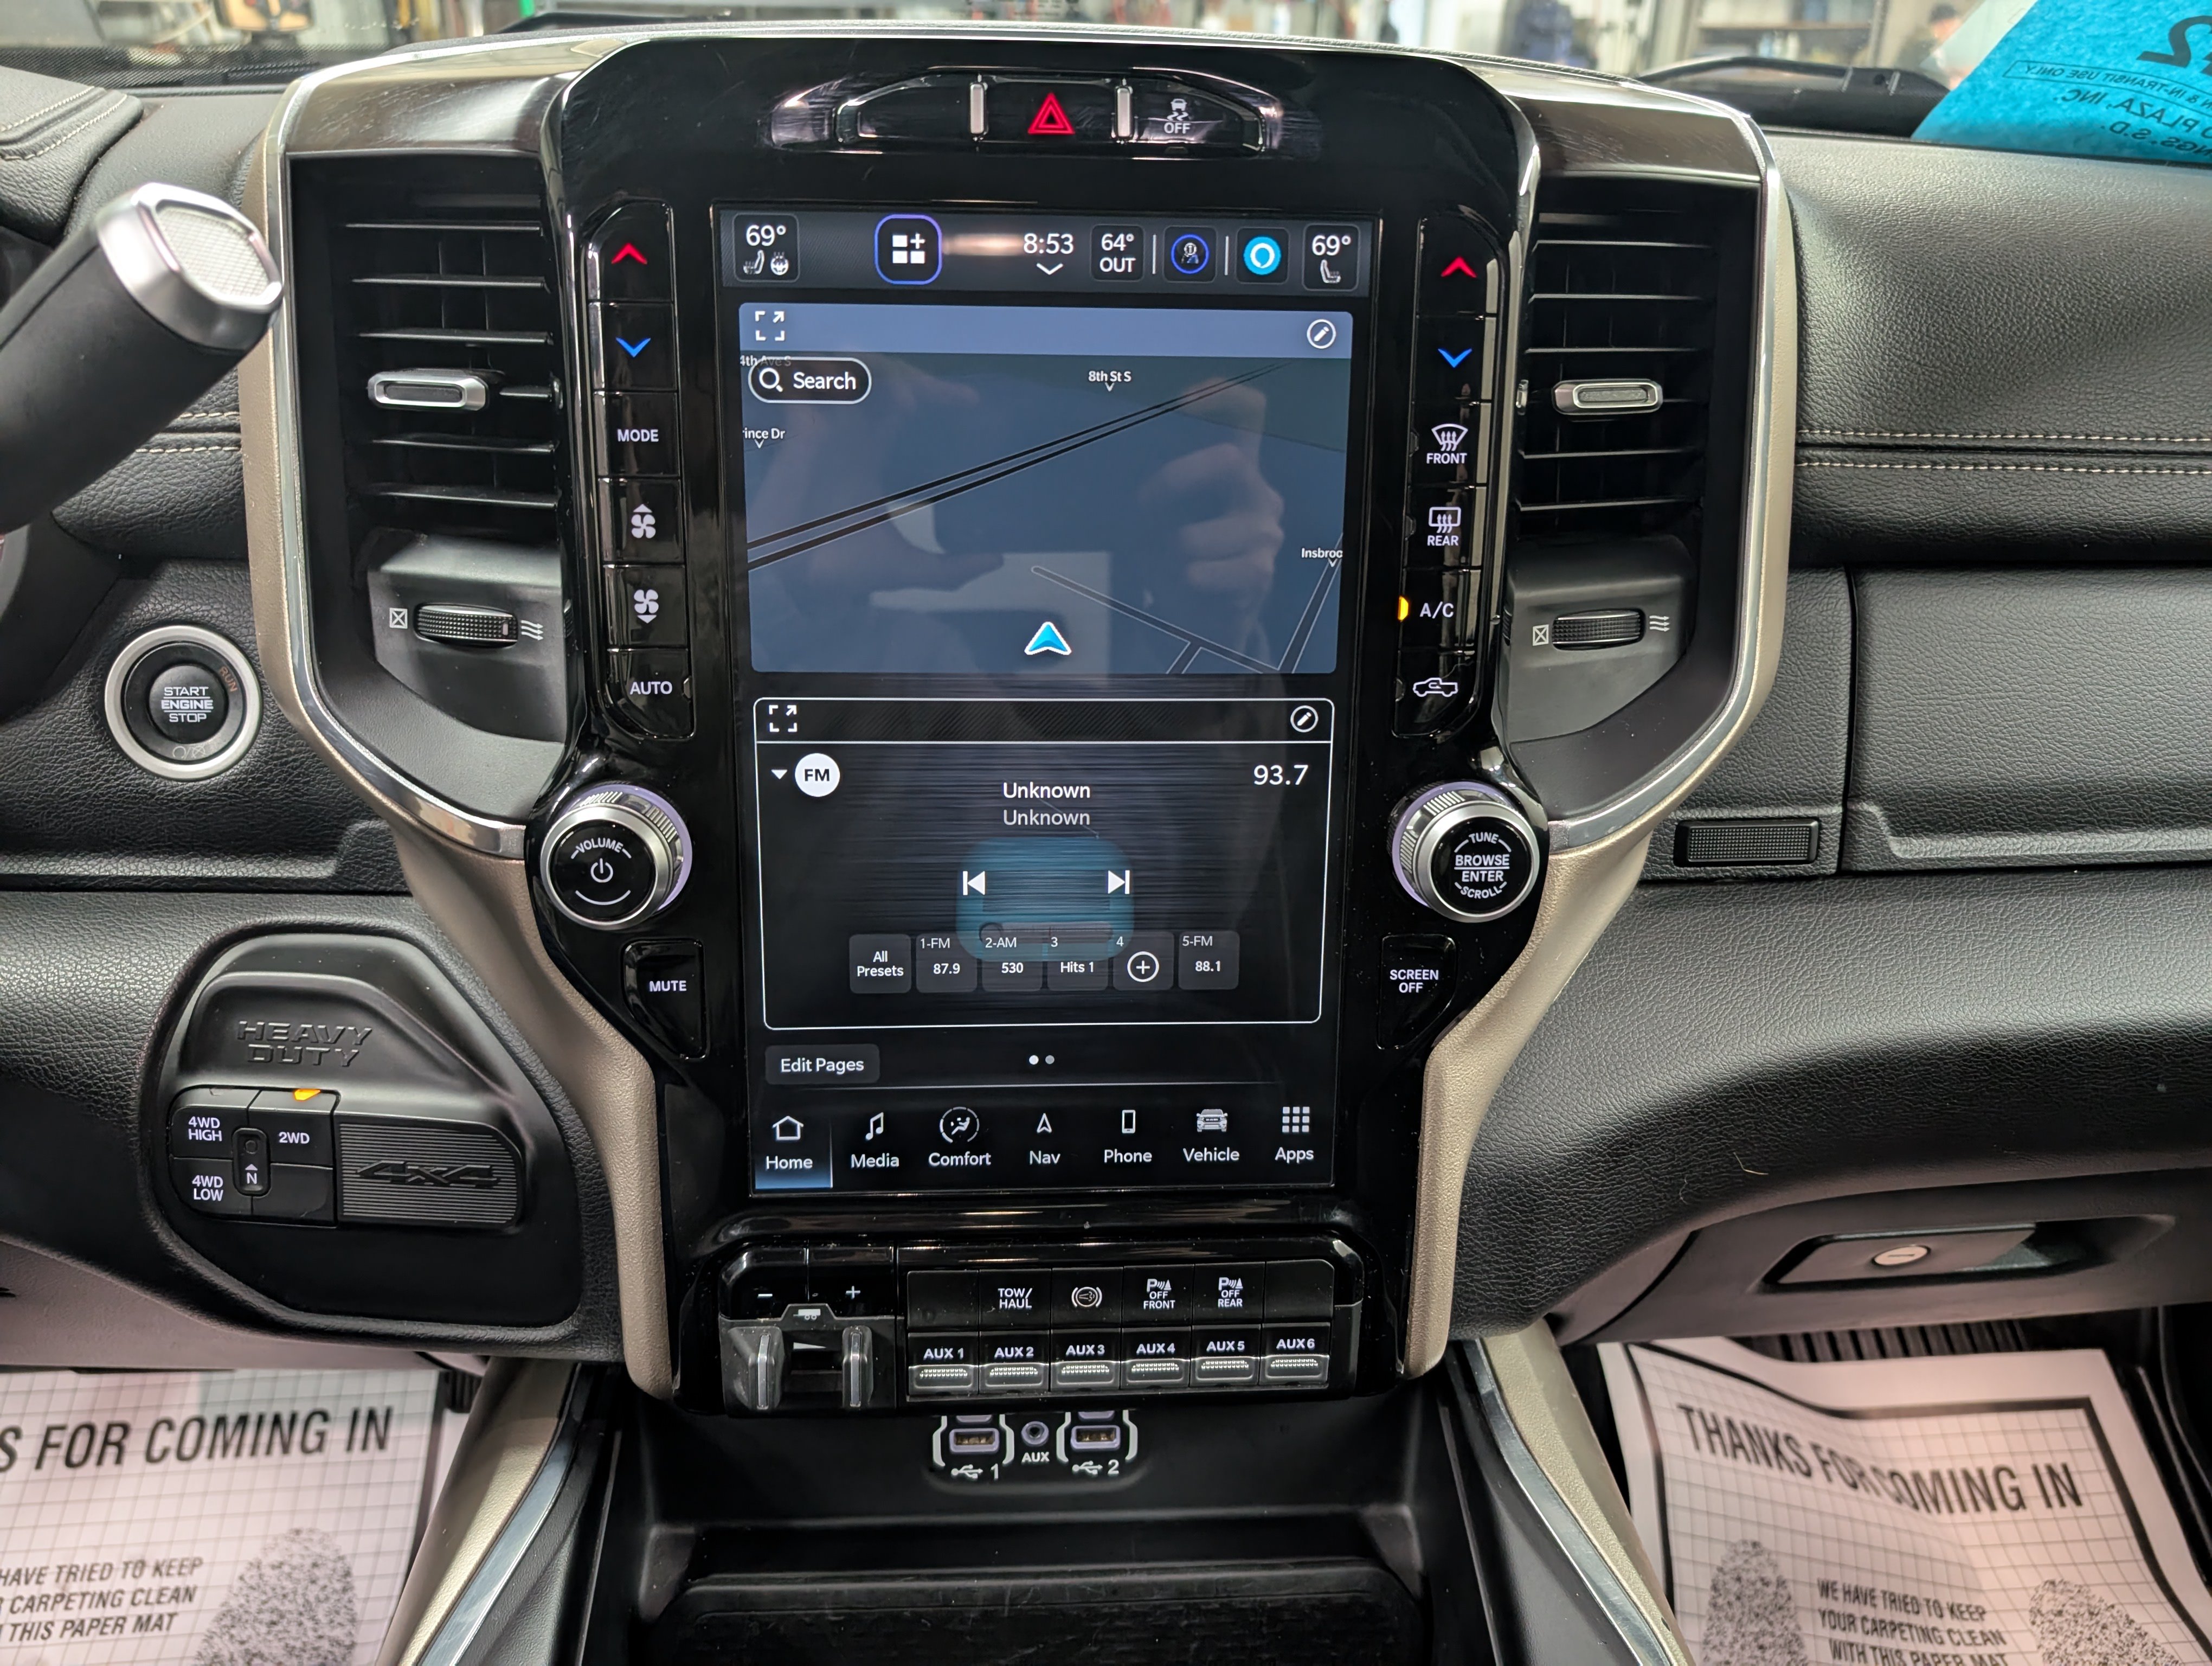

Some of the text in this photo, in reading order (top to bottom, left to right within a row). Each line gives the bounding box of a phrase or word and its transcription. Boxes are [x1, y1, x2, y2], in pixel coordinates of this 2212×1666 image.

[1163, 122, 1191, 133] OFF
[1023, 233, 1074, 254] 8:53
[1099, 257, 1136, 273] OUT
[793, 371, 857, 390] Search
[1088, 370, 1131, 382] 8th St S
[617, 429, 659, 443] MODE
[742, 427, 786, 439] ince Dr
[1426, 452, 1468, 464] FRONT
[1427, 535, 1459, 546] REAR
[1419, 601, 1454, 619] A/C
[218, 666, 238, 693] RUN
[164, 686, 209, 696] START
[629, 680, 673, 695] AUTO
[161, 700, 214, 710] ENGINE
[169, 713, 207, 722] STOP
[803, 768, 831, 783] FM
[1253, 764, 1309, 786] 93.7
[1002, 781, 1091, 799] Unknown
[1002, 809, 1091, 826] Unknown
[1468, 831, 1500, 845] TUNE
[576, 837, 624, 854] VOLUME
[1455, 854, 1510, 867] BROWSE
[1462, 870, 1504, 882] ENTER
[1459, 885, 1502, 899] SCROLL
[920, 938, 951, 949] 1-FM
[985, 937, 1017, 948] 2-AM
[1051, 937, 1058, 947] 3
[1116, 936, 1124, 947] 4
[1182, 936, 1213, 947] 5-FM
[872, 951, 888, 963] All
[857, 964, 904, 978] Presets
[933, 963, 961, 975] 87.9
[1001, 962, 1024, 973] 530
[1060, 961, 1094, 973] Hits 1
[1195, 960, 1221, 972] 88.1
[1390, 969, 1439, 981] SCREEN
[649, 980, 687, 992] MUTE
[1399, 982, 1424, 994] OFF
[237, 1020, 372, 1046] HEAVY
[247, 1044, 359, 1067] DUTY
[781, 1057, 864, 1075] Edit Pages
[188, 1116, 220, 1129] 4WD
[188, 1129, 222, 1142] HIGH
[279, 1132, 310, 1144] 2WD
[851, 1154, 900, 1168] Media
[928, 1151, 992, 1167] Comfort
[1029, 1150, 1061, 1165] Nav
[1103, 1149, 1153, 1163] Phone
[1182, 1147, 1240, 1162] Vehicle
[1275, 1147, 1314, 1164] Apps
[766, 1156, 813, 1170] Home
[192, 1175, 223, 1188] 4WD
[246, 1172, 258, 1184] N
[193, 1188, 223, 1201] LOW
[998, 1287, 1033, 1299] TOW/
[1149, 1291, 1168, 1299] OFF
[1221, 1290, 1240, 1298] OFF
[999, 1299, 1032, 1310] HAUL
[1143, 1300, 1176, 1310] FRONT
[1218, 1299, 1243, 1308] REAR
[1066, 1345, 1105, 1355] AUX 3
[1136, 1343, 1176, 1354] AUX 4
[1206, 1341, 1245, 1351] AUX 5
[1276, 1338, 1315, 1349] AUX 6
[923, 1348, 964, 1359] AUX 1
[994, 1347, 1034, 1357] AUX 2
[35, 1421, 132, 1471] FOR
[145, 1409, 331, 1464] COMING
[346, 1406, 394, 1452] IN
[1021, 1452, 1050, 1463] AUX
[1676, 1402, 2083, 1514] THANKS FOR COMING IN
[991, 1463, 999, 1481] 1
[1108, 1460, 1120, 1475] 2
[0, 1556, 203, 1586] HAVE TRIED TO KEEP
[9, 1589, 125, 1614] CARPETING
[131, 1585, 197, 1607] CLEAN
[1817, 1577, 1987, 1622] WE HAVE TRIED TO KEEP
[9, 1620, 55, 1642] THIS
[59, 1616, 127, 1638] PAPER
[132, 1612, 178, 1633] MAT
[1817, 1607, 2008, 1646] YOUR CARPETING CLEAN
[1828, 1637, 2008, 1666] WITH THIS PAPER MAT
